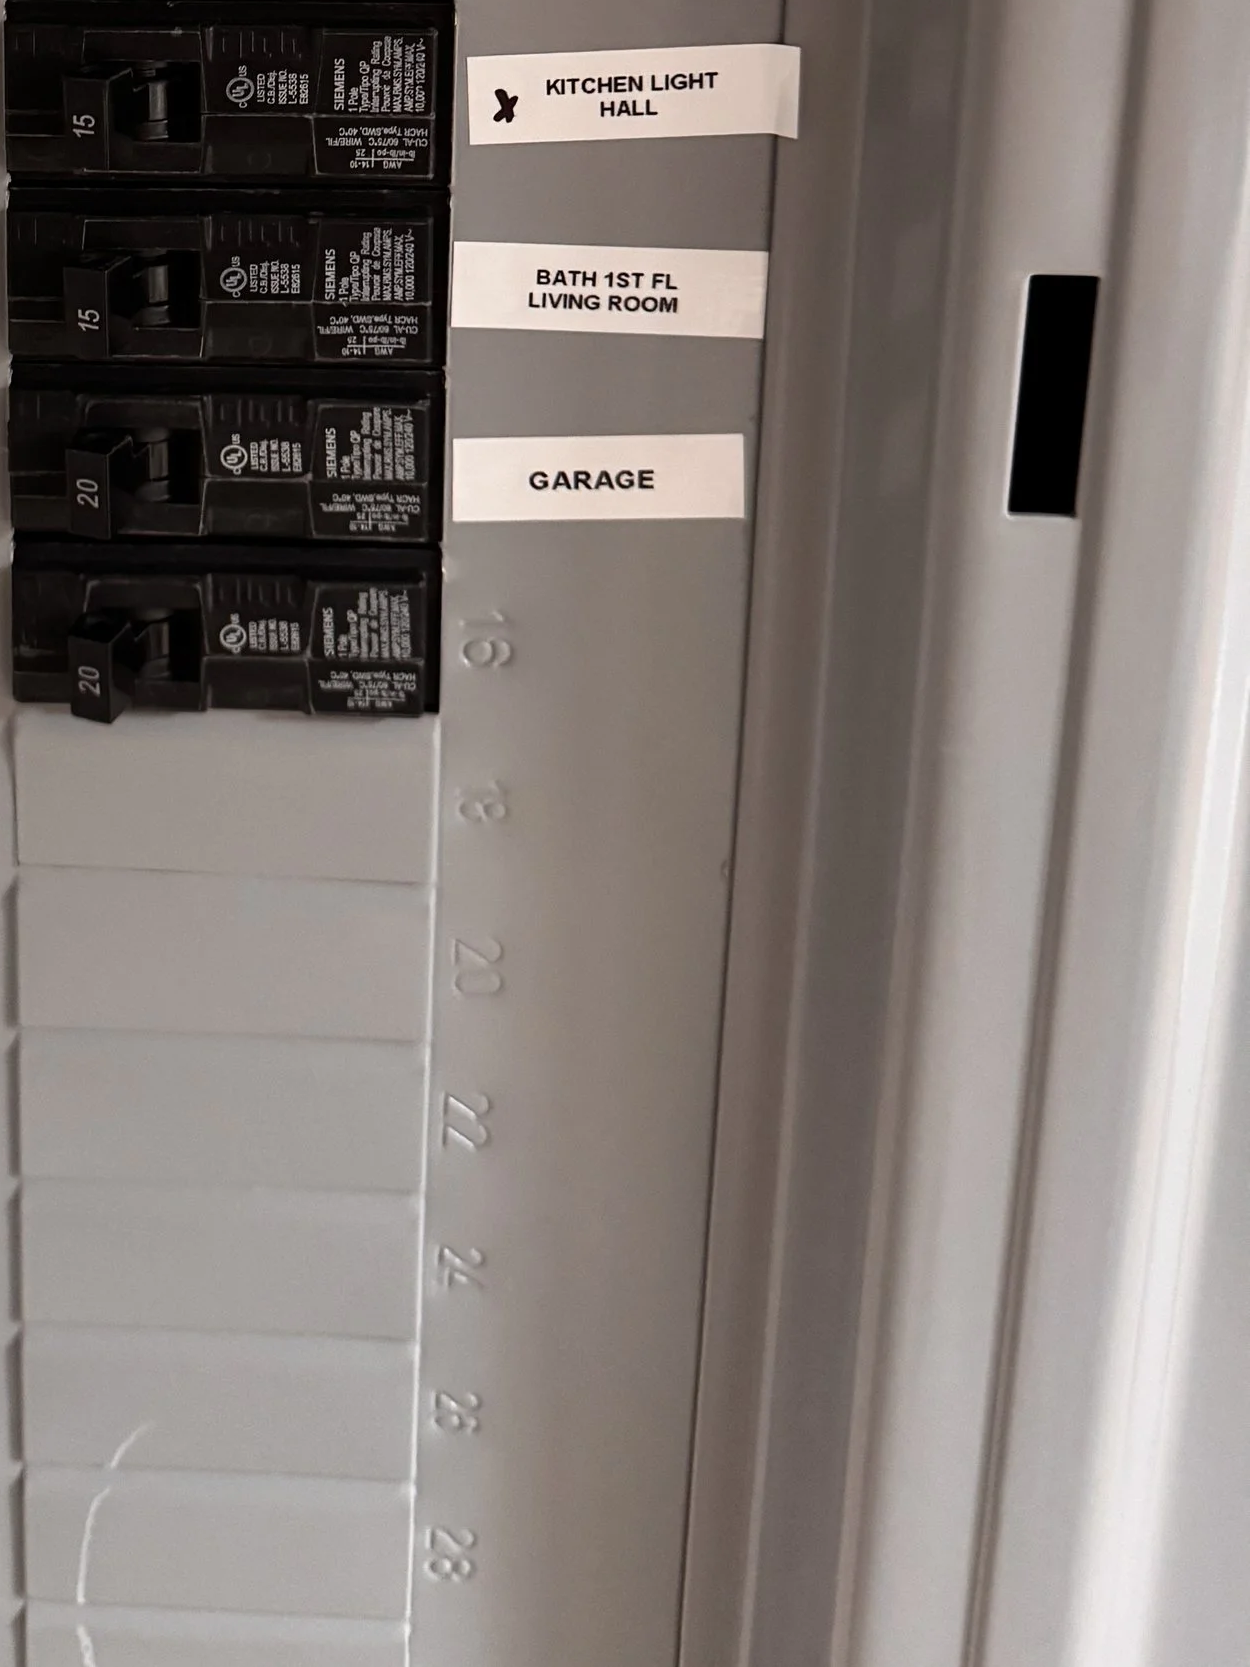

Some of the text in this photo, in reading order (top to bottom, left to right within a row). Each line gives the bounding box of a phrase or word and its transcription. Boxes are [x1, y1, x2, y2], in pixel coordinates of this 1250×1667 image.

[288, 73, 298, 104] L-5538
[334, 58, 346, 111] SIEMENS
[348, 87, 359, 106] Pole
[545, 72, 718, 95] KITCHEN LIGHT
[600, 100, 658, 117] HALL
[72, 114, 95, 138] 15
[280, 263, 290, 294] L-5538
[291, 263, 301, 294] E82615
[325, 248, 336, 301] SIEMENS
[536, 269, 678, 290] BATH 1ST FL
[528, 292, 678, 313] LIVING ROOM
[77, 308, 99, 332] 15
[325, 427, 338, 478] SIEMENS
[76, 478, 99, 509] 20
[528, 469, 655, 490] GARAGE
[322, 606, 335, 657] SIEMENS
[78, 666, 101, 697] 20
